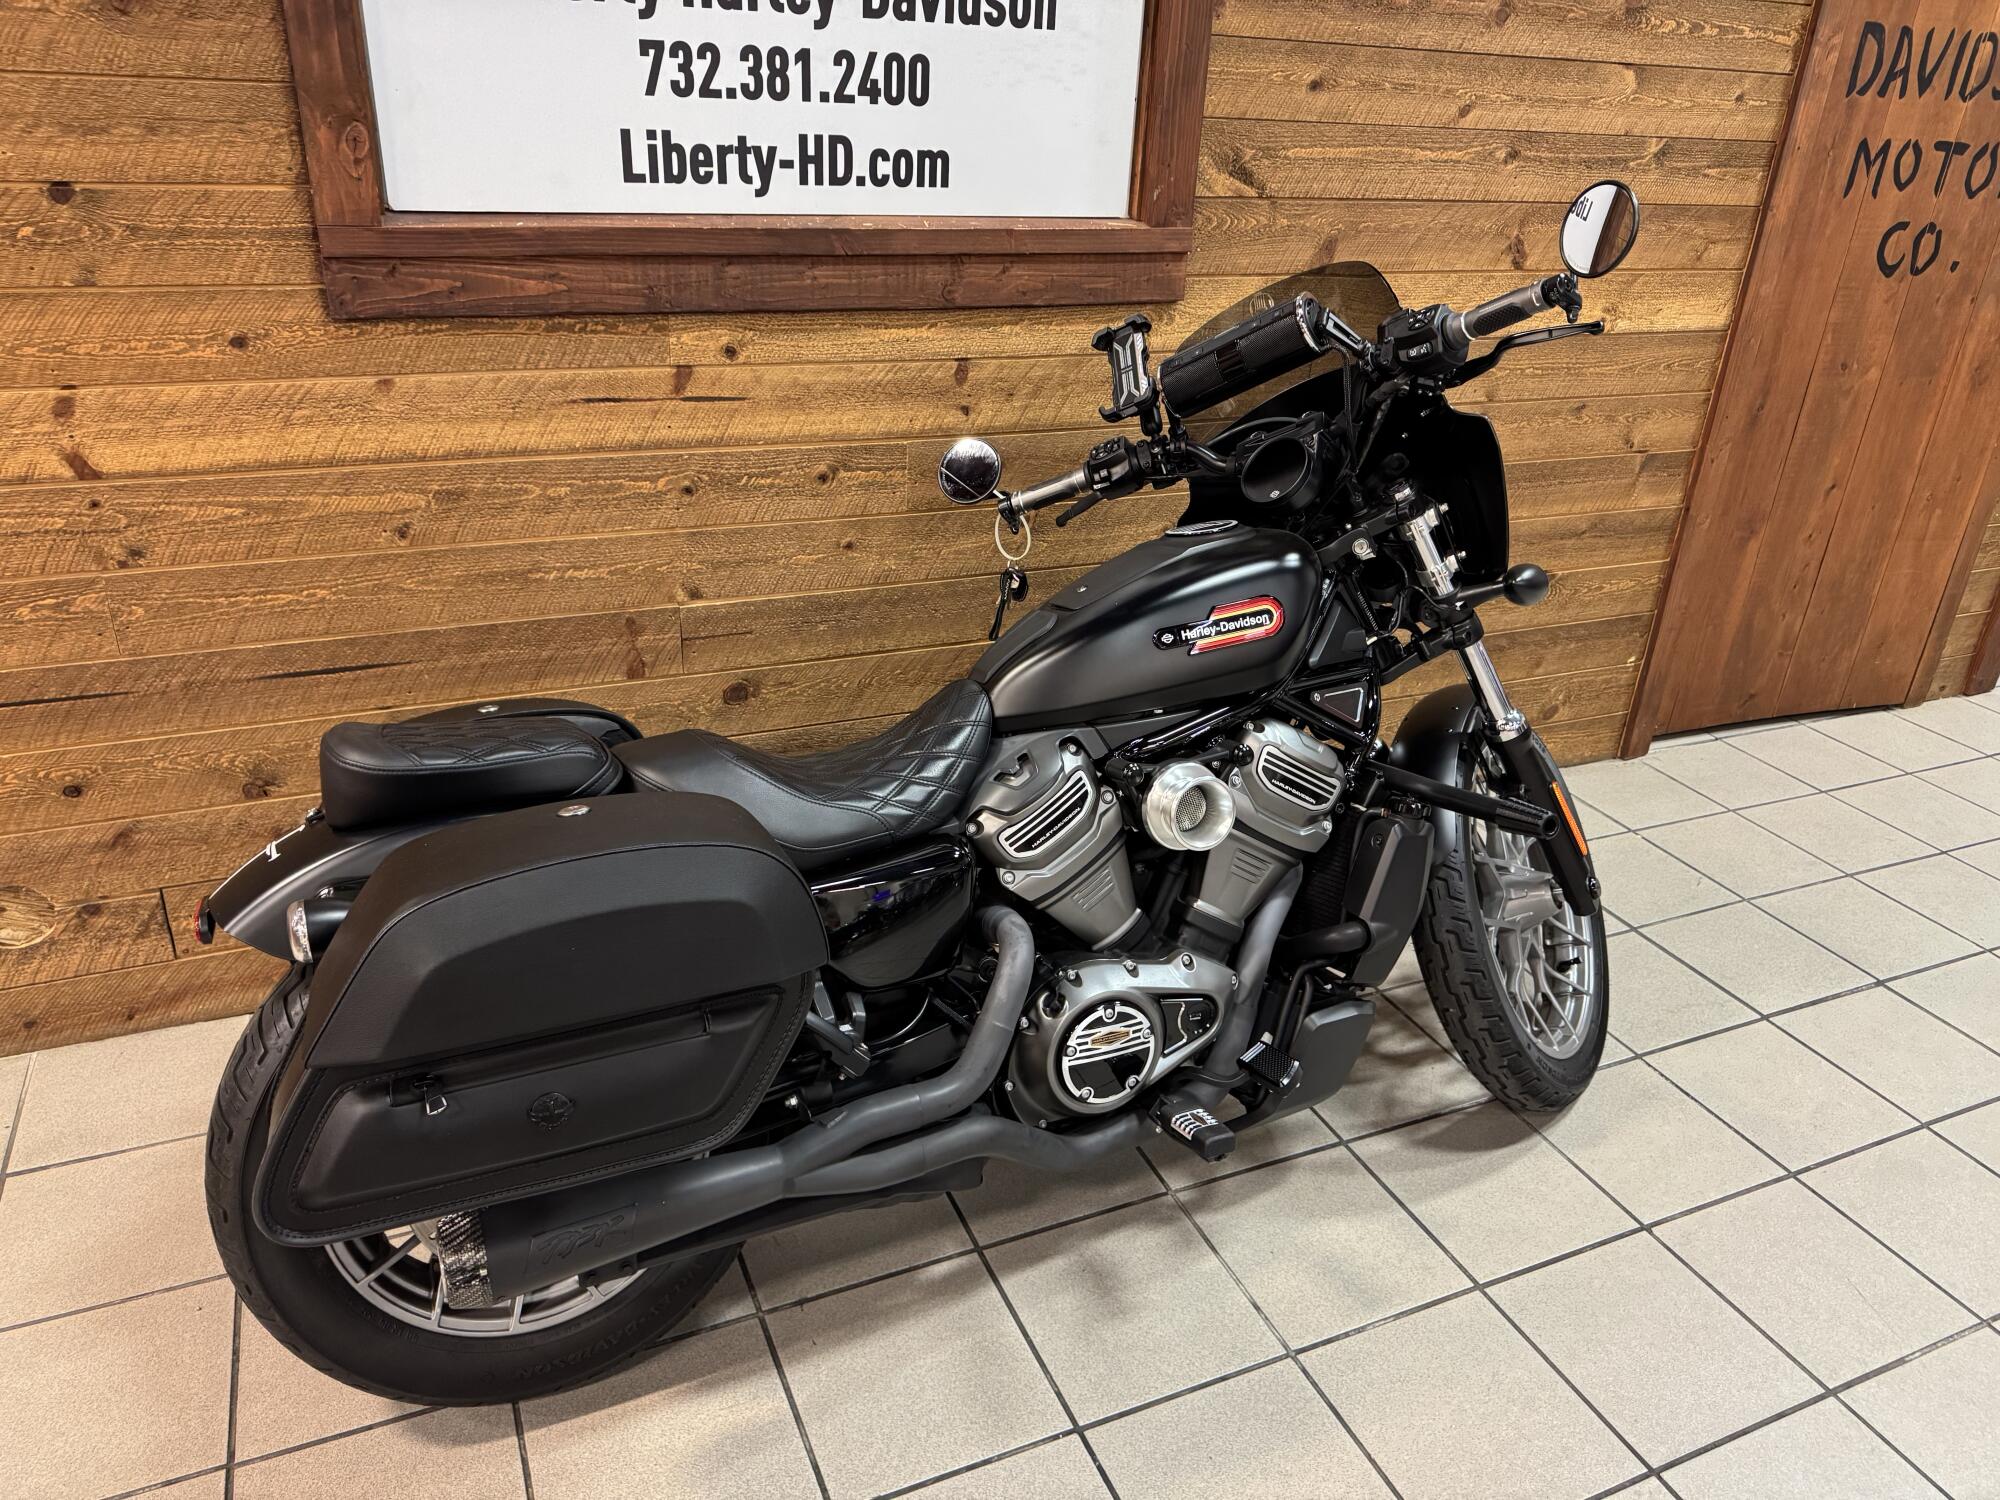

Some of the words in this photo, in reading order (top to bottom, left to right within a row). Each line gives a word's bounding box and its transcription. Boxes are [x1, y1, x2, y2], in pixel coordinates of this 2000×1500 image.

[638, 38, 930, 107] 732.381.2400
[1846, 21, 2000, 103] DAVID
[620, 128, 950, 198] Liberty-HD.com
[1843, 137, 2000, 200] MOTO
[1876, 221, 1960, 279] CO.
[1181, 613, 1271, 641] Harley-Davidson
